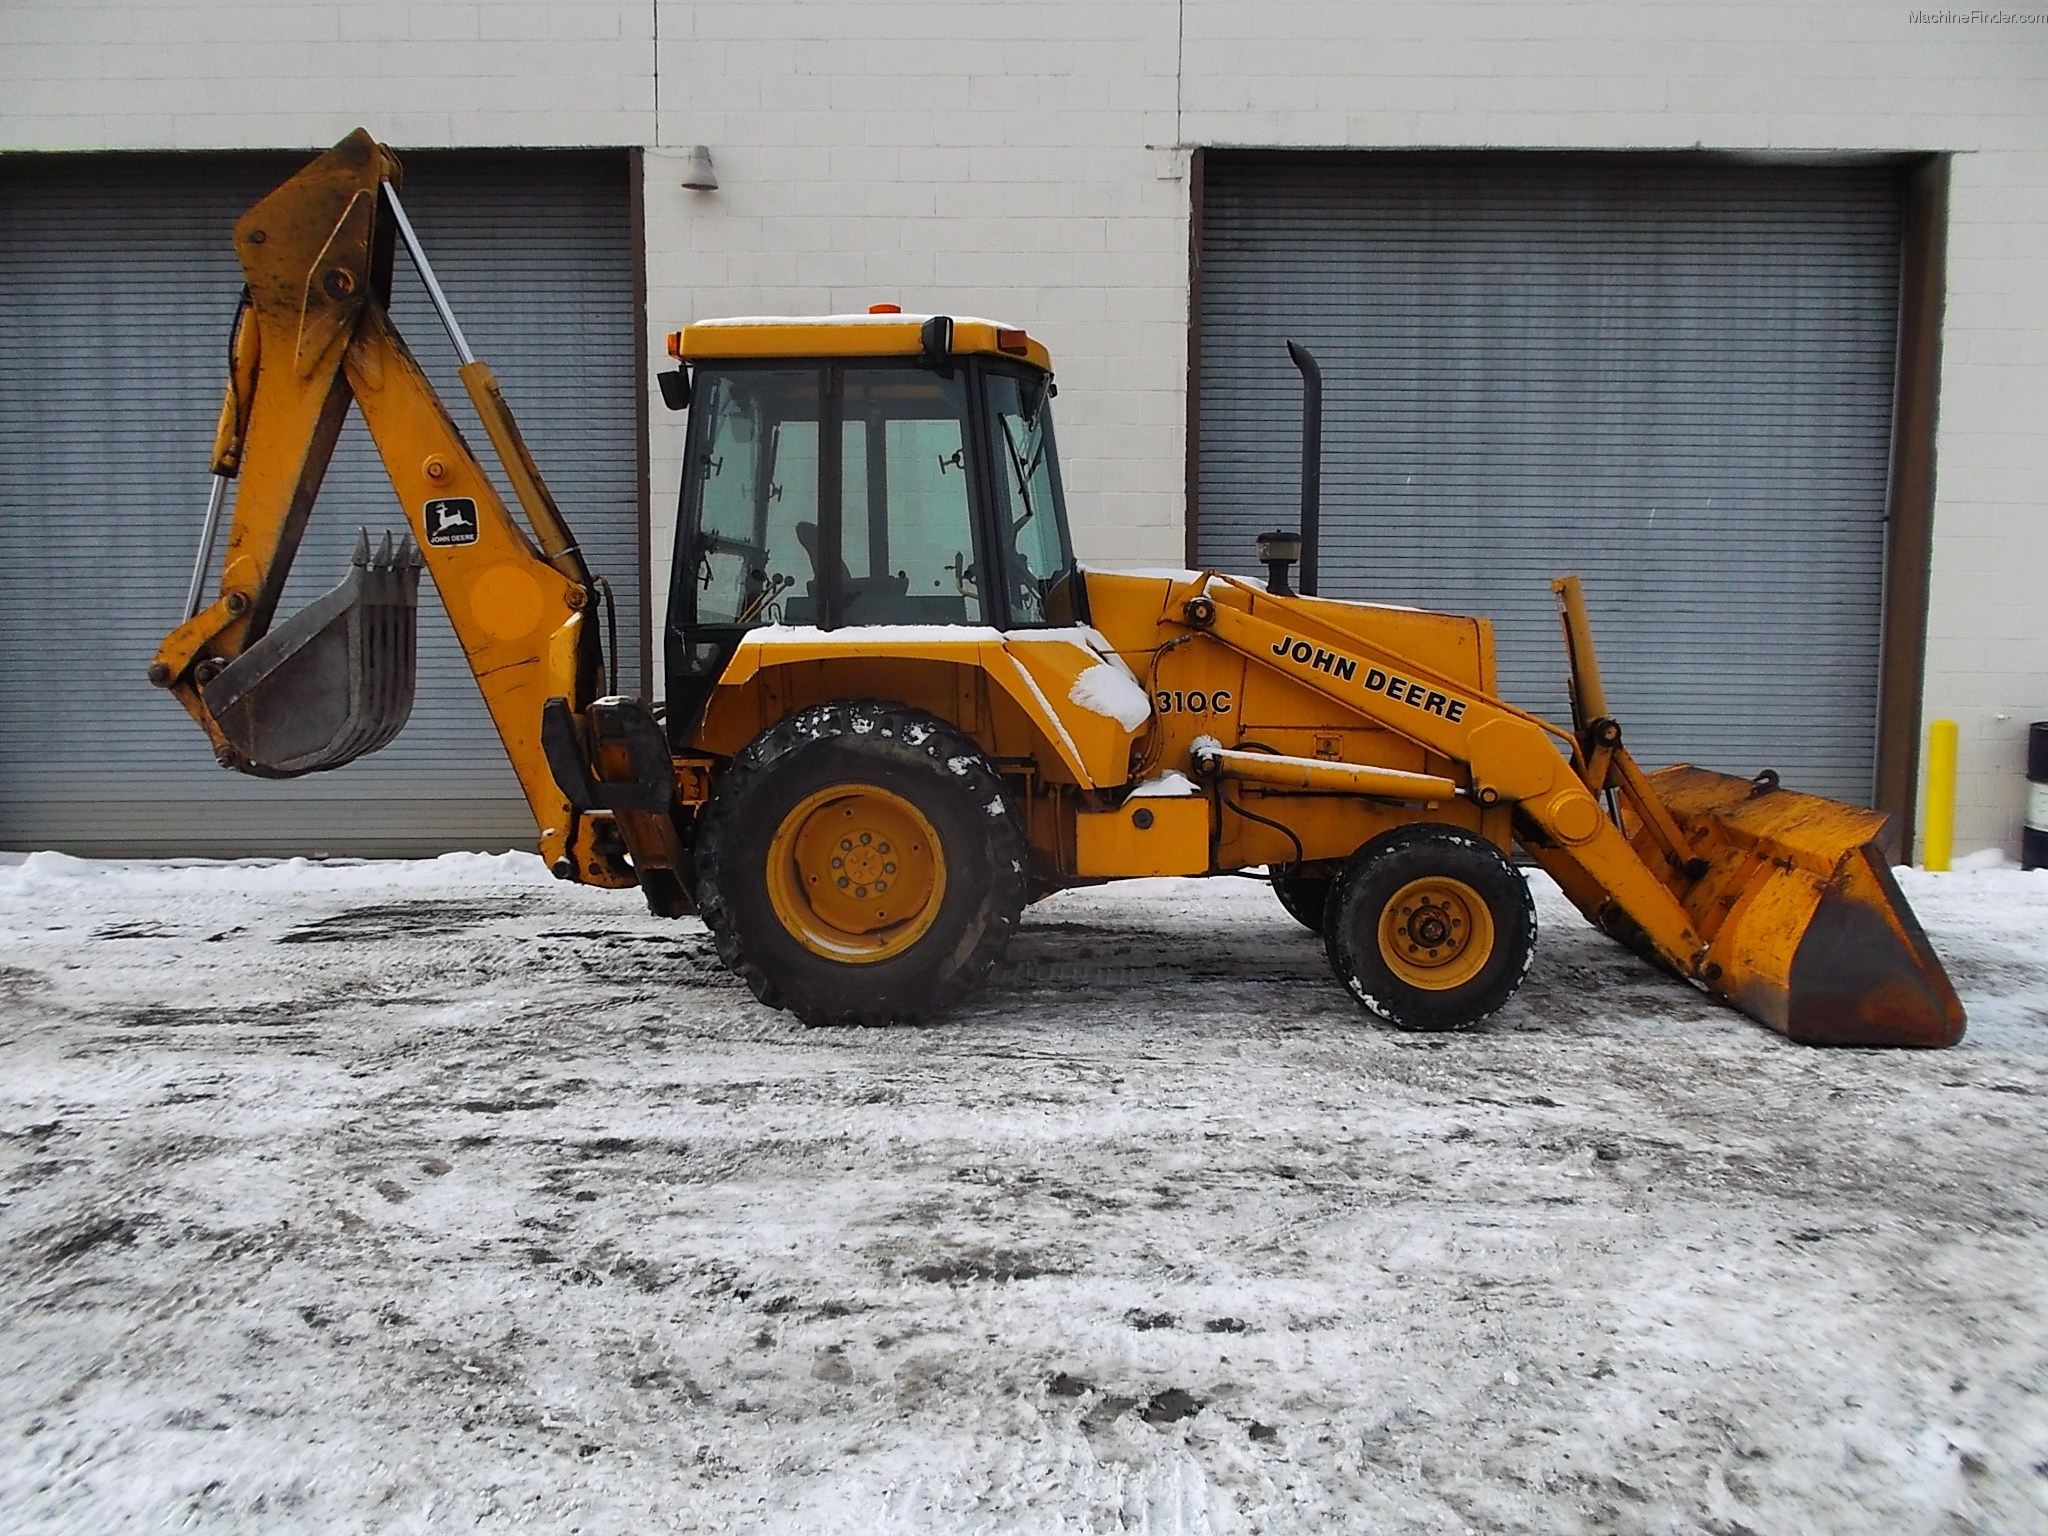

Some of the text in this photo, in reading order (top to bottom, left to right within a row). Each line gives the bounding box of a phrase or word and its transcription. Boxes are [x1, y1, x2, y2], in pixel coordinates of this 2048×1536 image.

[430, 534, 475, 543] JOHN DEERE
[1272, 636, 1467, 724] JOHN DEERE
[1156, 690, 1232, 714] 310C
